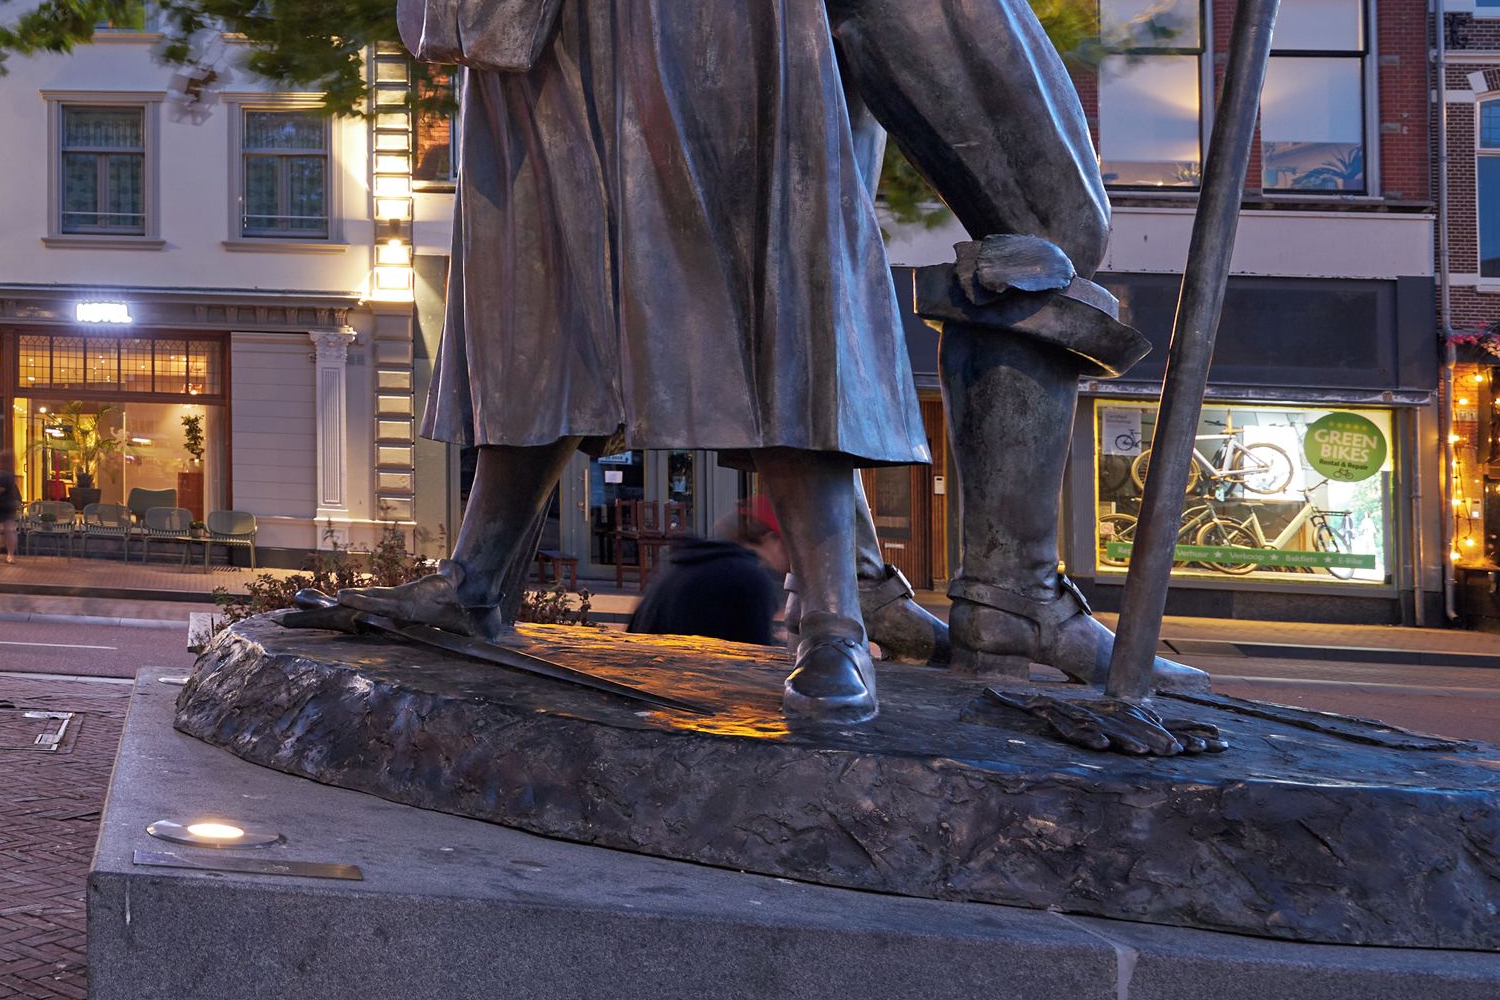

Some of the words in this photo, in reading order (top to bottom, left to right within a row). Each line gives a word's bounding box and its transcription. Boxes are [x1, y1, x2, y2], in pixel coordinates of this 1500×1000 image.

[1314, 428, 1378, 449] GREEN
[1320, 443, 1370, 463] BIKES
[1318, 458, 1340, 467] Rental
[1347, 462, 1369, 471] Repair
[1229, 552, 1265, 562] Verkoop
